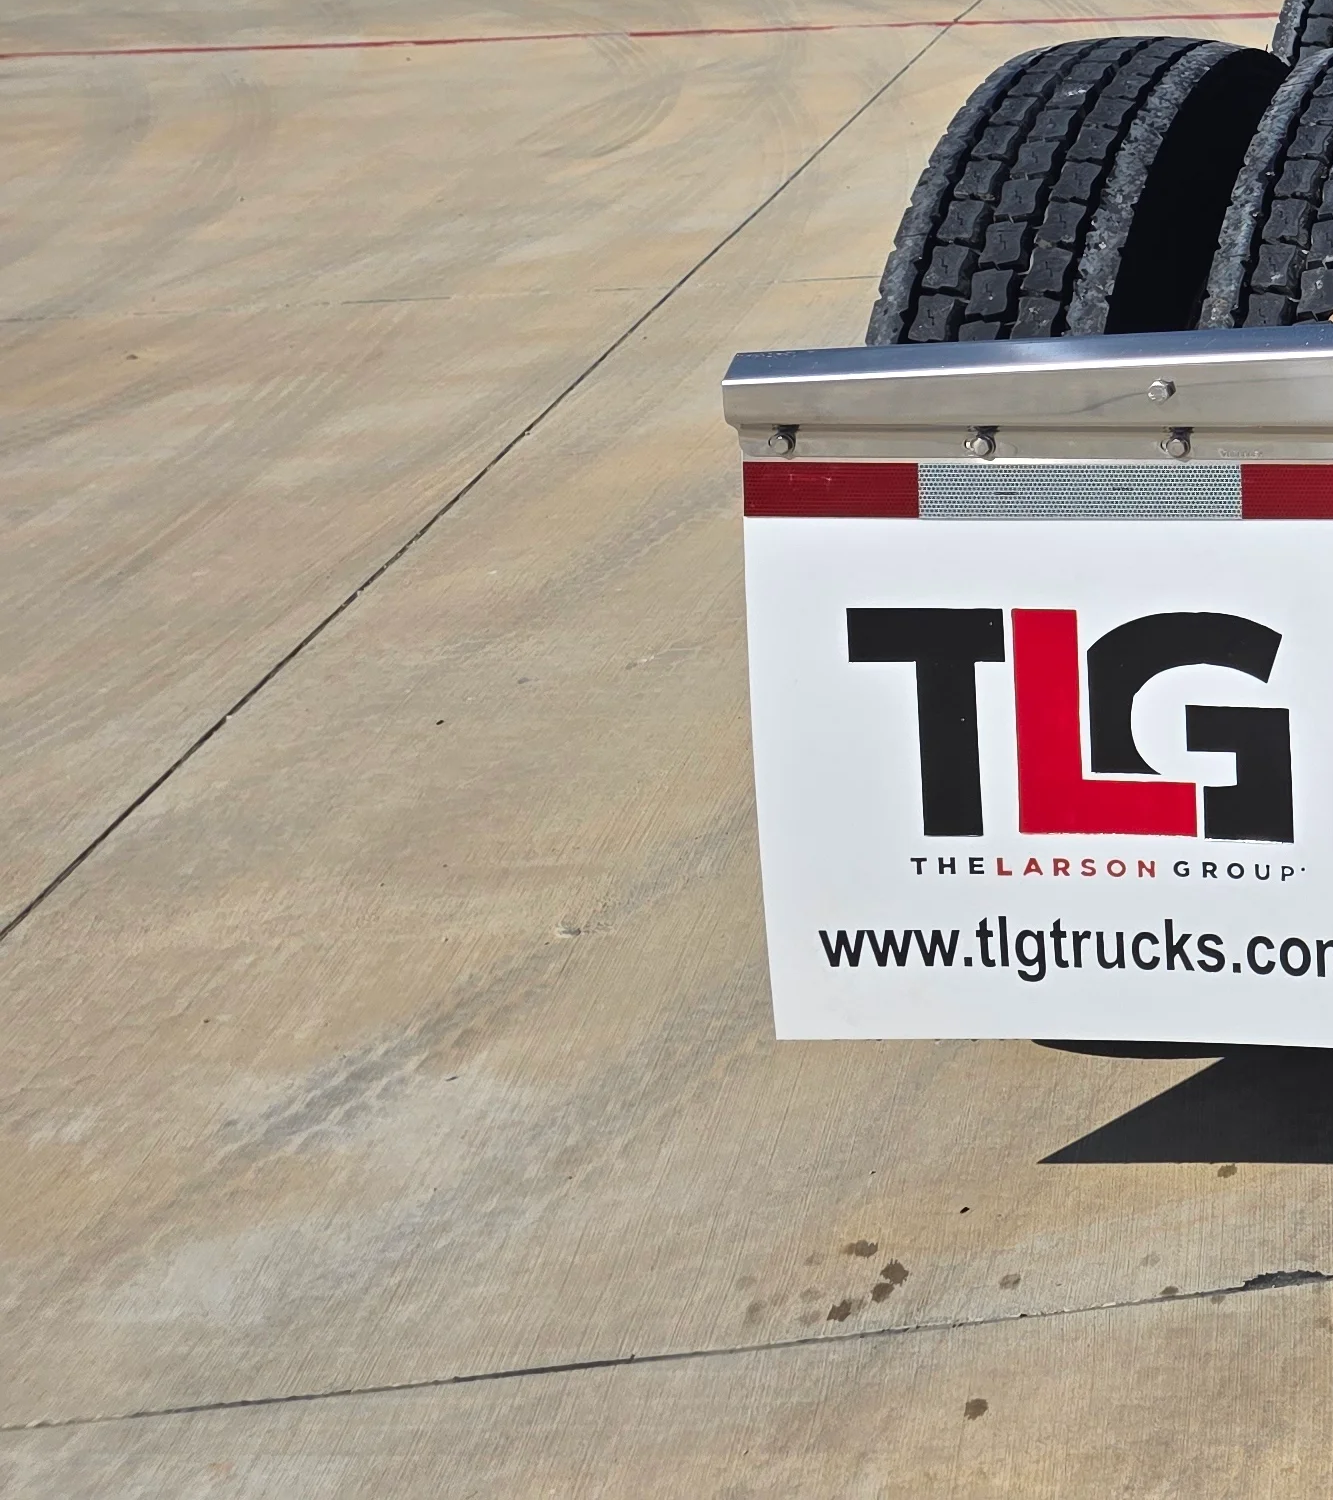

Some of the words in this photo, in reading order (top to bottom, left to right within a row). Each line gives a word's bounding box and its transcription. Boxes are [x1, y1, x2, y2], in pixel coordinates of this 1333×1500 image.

[846, 608, 1294, 843] TLG
[910, 856, 985, 876] THE
[996, 857, 1156, 878] LARSON
[1173, 860, 1295, 882] GROUP
